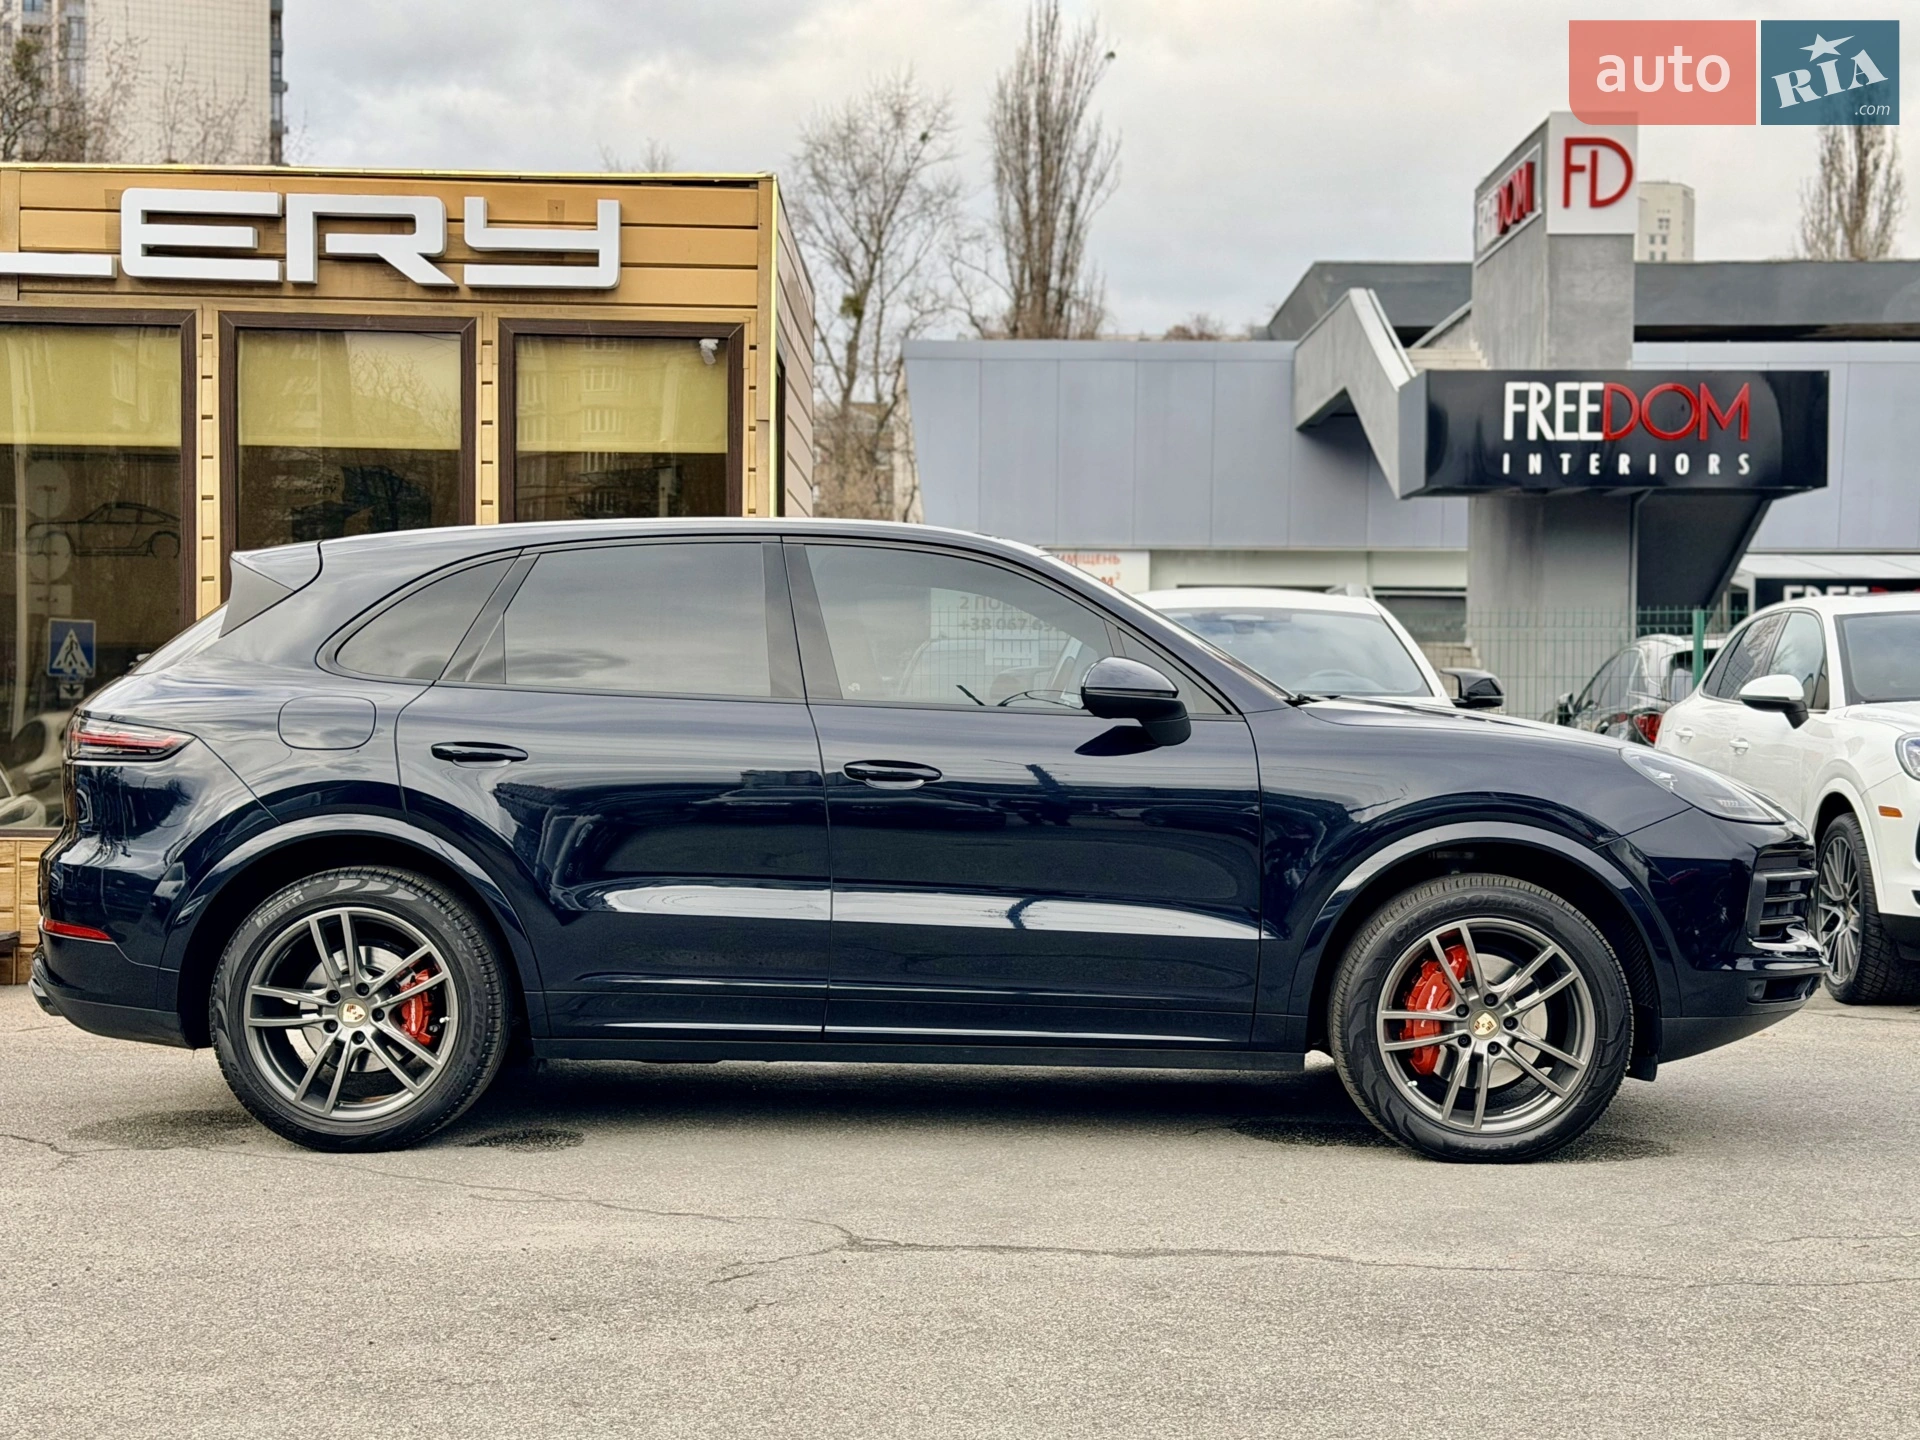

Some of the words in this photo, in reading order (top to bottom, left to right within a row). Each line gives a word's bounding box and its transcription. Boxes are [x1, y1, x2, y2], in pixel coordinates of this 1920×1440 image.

[1563, 136, 1634, 209] FD
[1503, 381, 1750, 441] FREEDOM
[1502, 452, 1751, 476] INTERIORS
[960, 597, 969, 609] 2
[959, 618, 993, 631] +38
